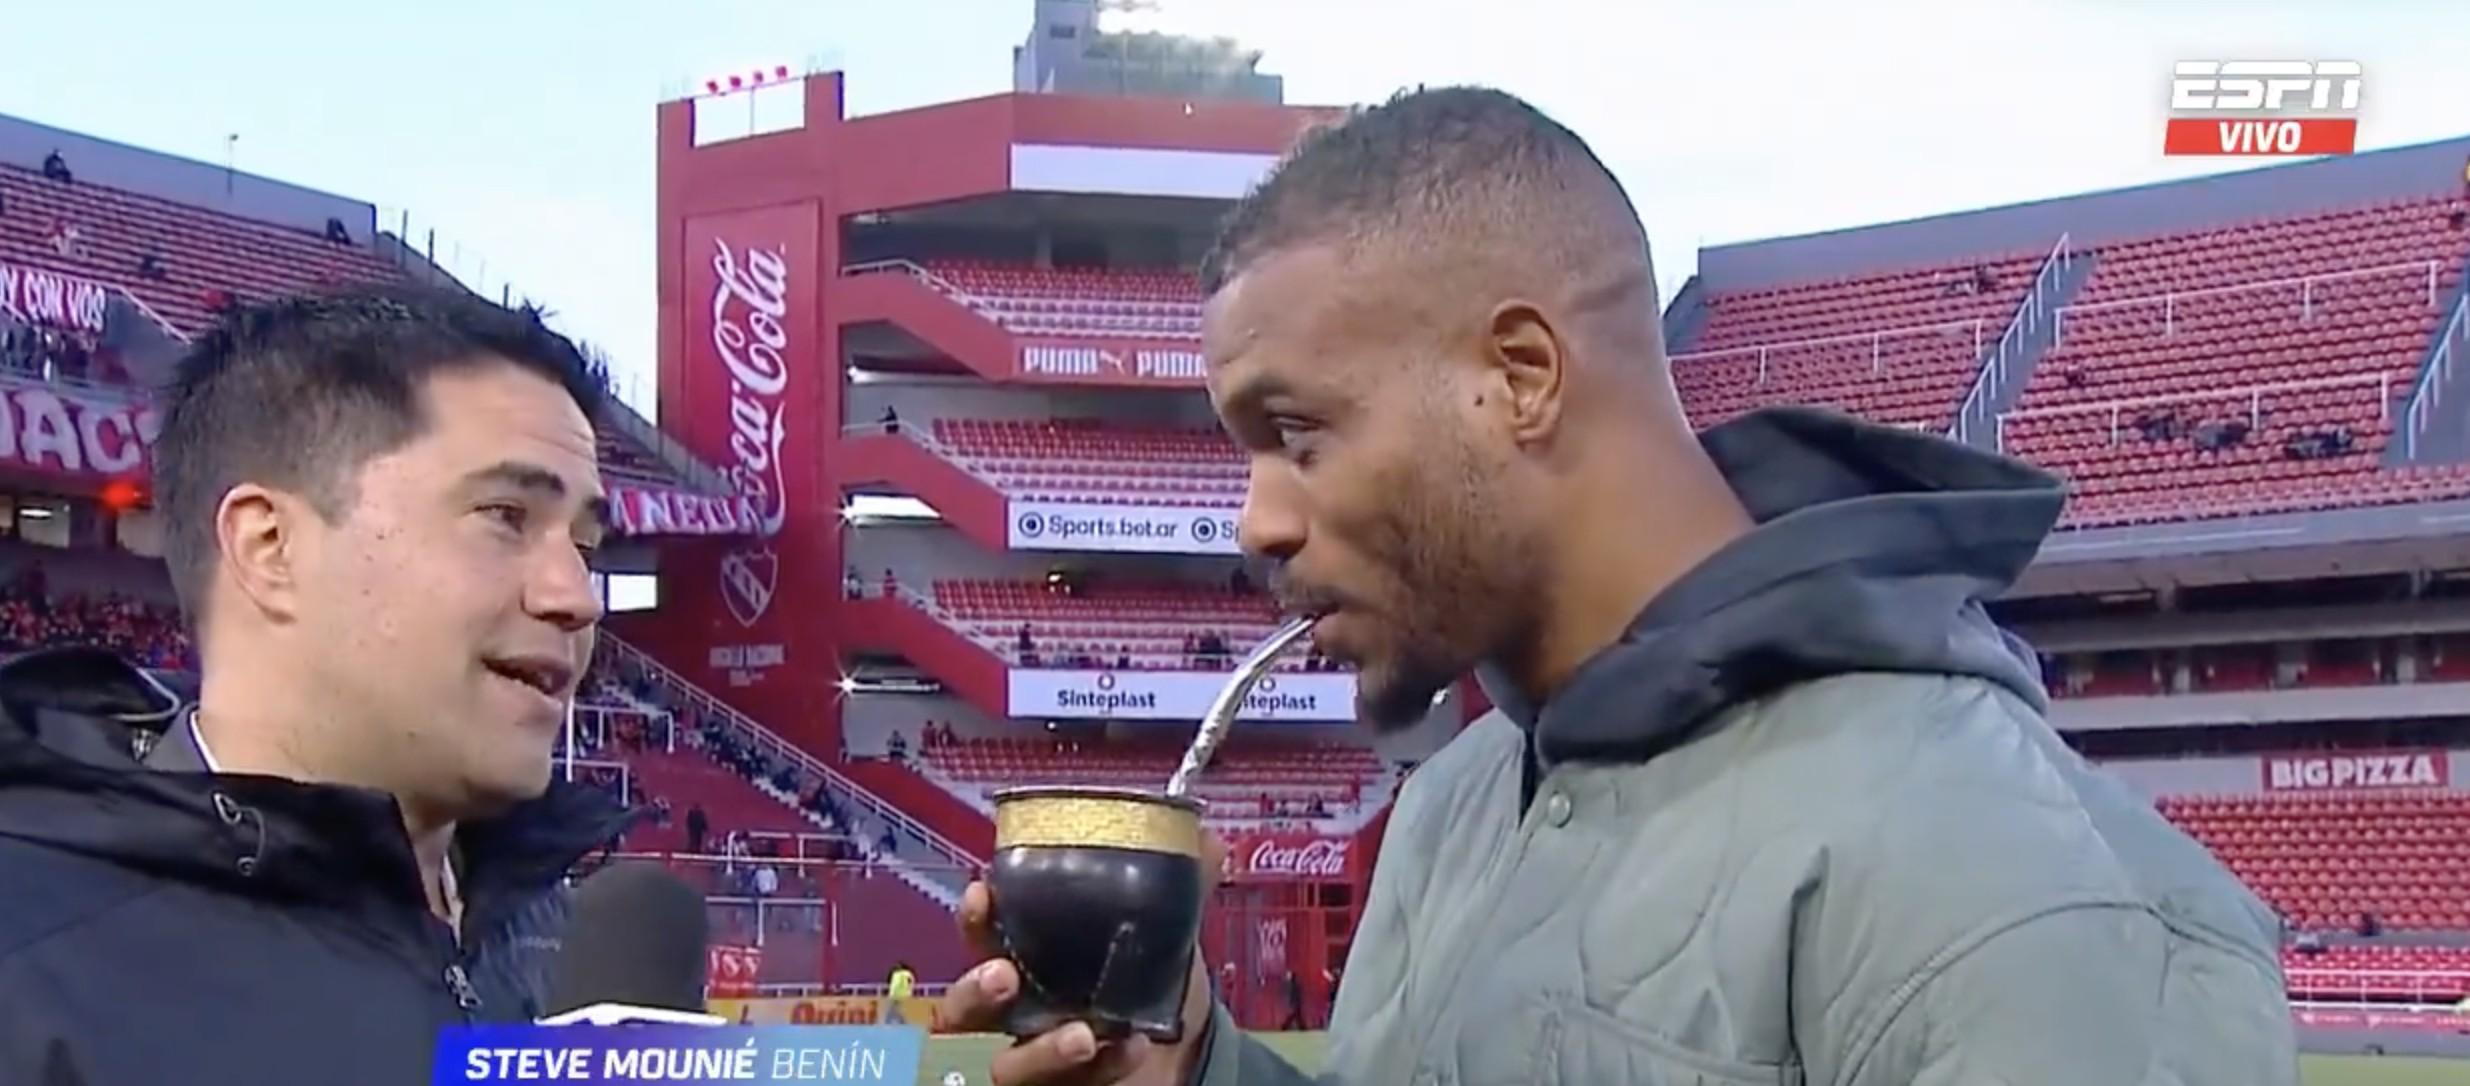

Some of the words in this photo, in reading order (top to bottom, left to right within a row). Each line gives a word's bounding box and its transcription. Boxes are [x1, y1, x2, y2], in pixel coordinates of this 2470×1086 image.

[67, 282, 106, 332] VOS
[1024, 347, 1099, 374] PUMA
[1049, 515, 1178, 538] Sports.bet.ar
[1057, 689, 1156, 710] Sinteplast
[2271, 758, 2330, 788] BIG
[2332, 754, 2438, 787] PIZZA
